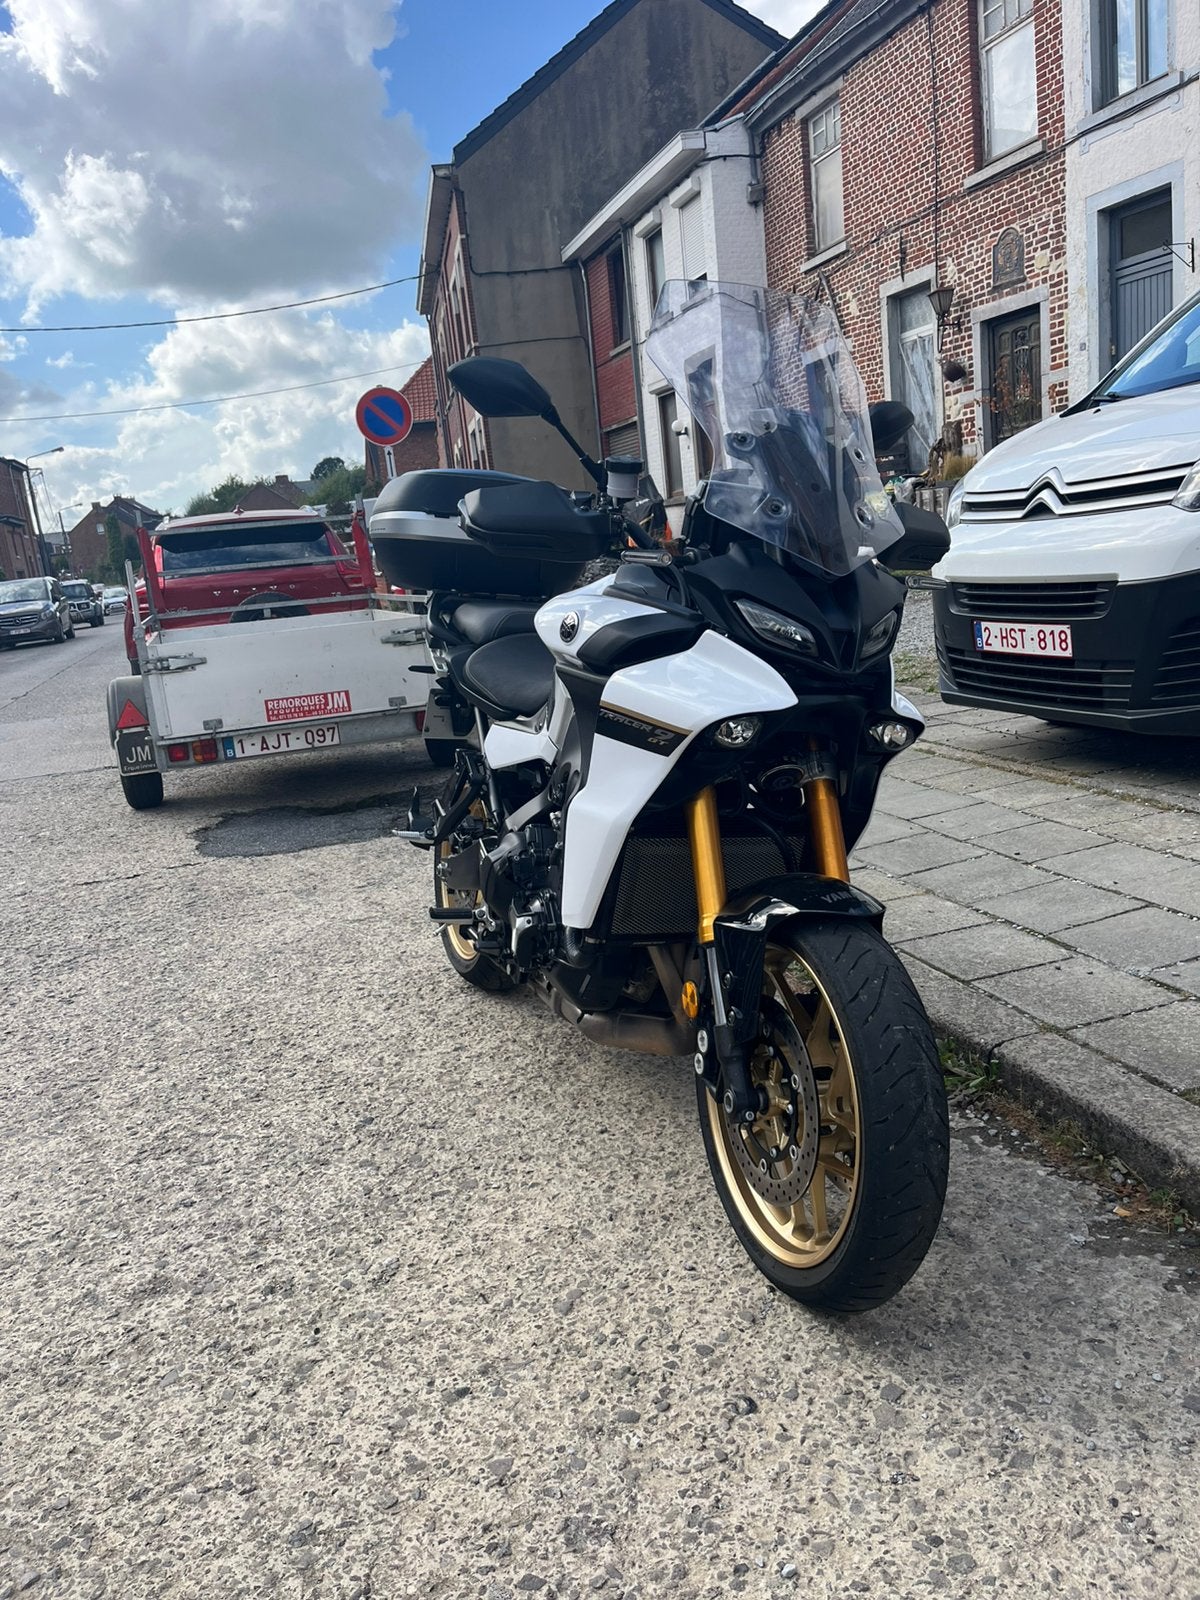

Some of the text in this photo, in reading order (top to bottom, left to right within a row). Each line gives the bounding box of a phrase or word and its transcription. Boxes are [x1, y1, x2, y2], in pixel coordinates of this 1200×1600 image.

[977, 626, 1069, 652] B 2-HST-818
[267, 694, 326, 710] REMORQUES
[326, 691, 348, 709] JM
[599, 708, 677, 741] TRACER 9
[226, 726, 336, 757] B 1-AJT-097
[647, 737, 669, 746] GT
[126, 745, 152, 763] JM
